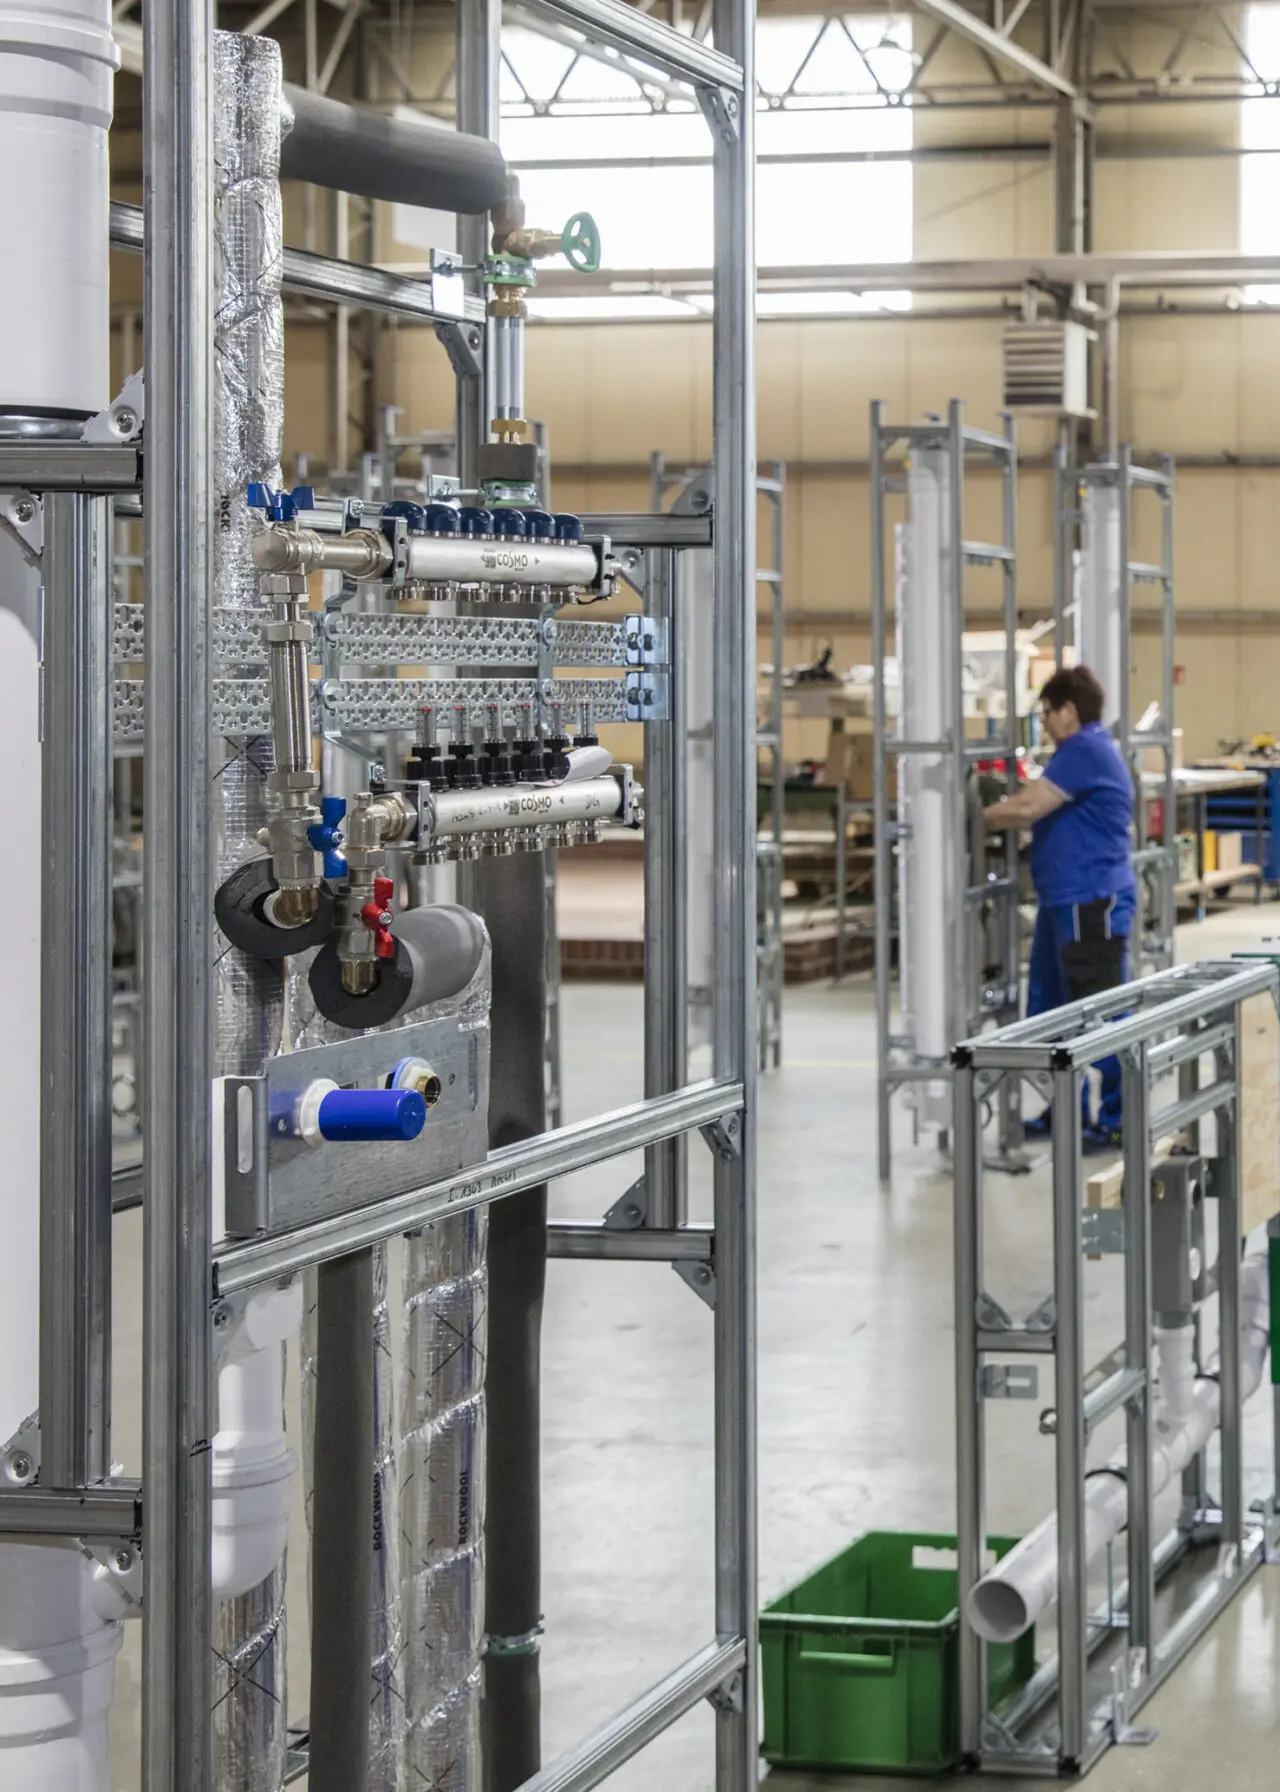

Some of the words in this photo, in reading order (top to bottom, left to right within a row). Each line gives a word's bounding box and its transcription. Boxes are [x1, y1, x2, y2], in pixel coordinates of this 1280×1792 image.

[497, 552, 528, 568] COSMO
[521, 795, 553, 812] COSMO
[459, 1469, 469, 1544] ROCKWOOL
